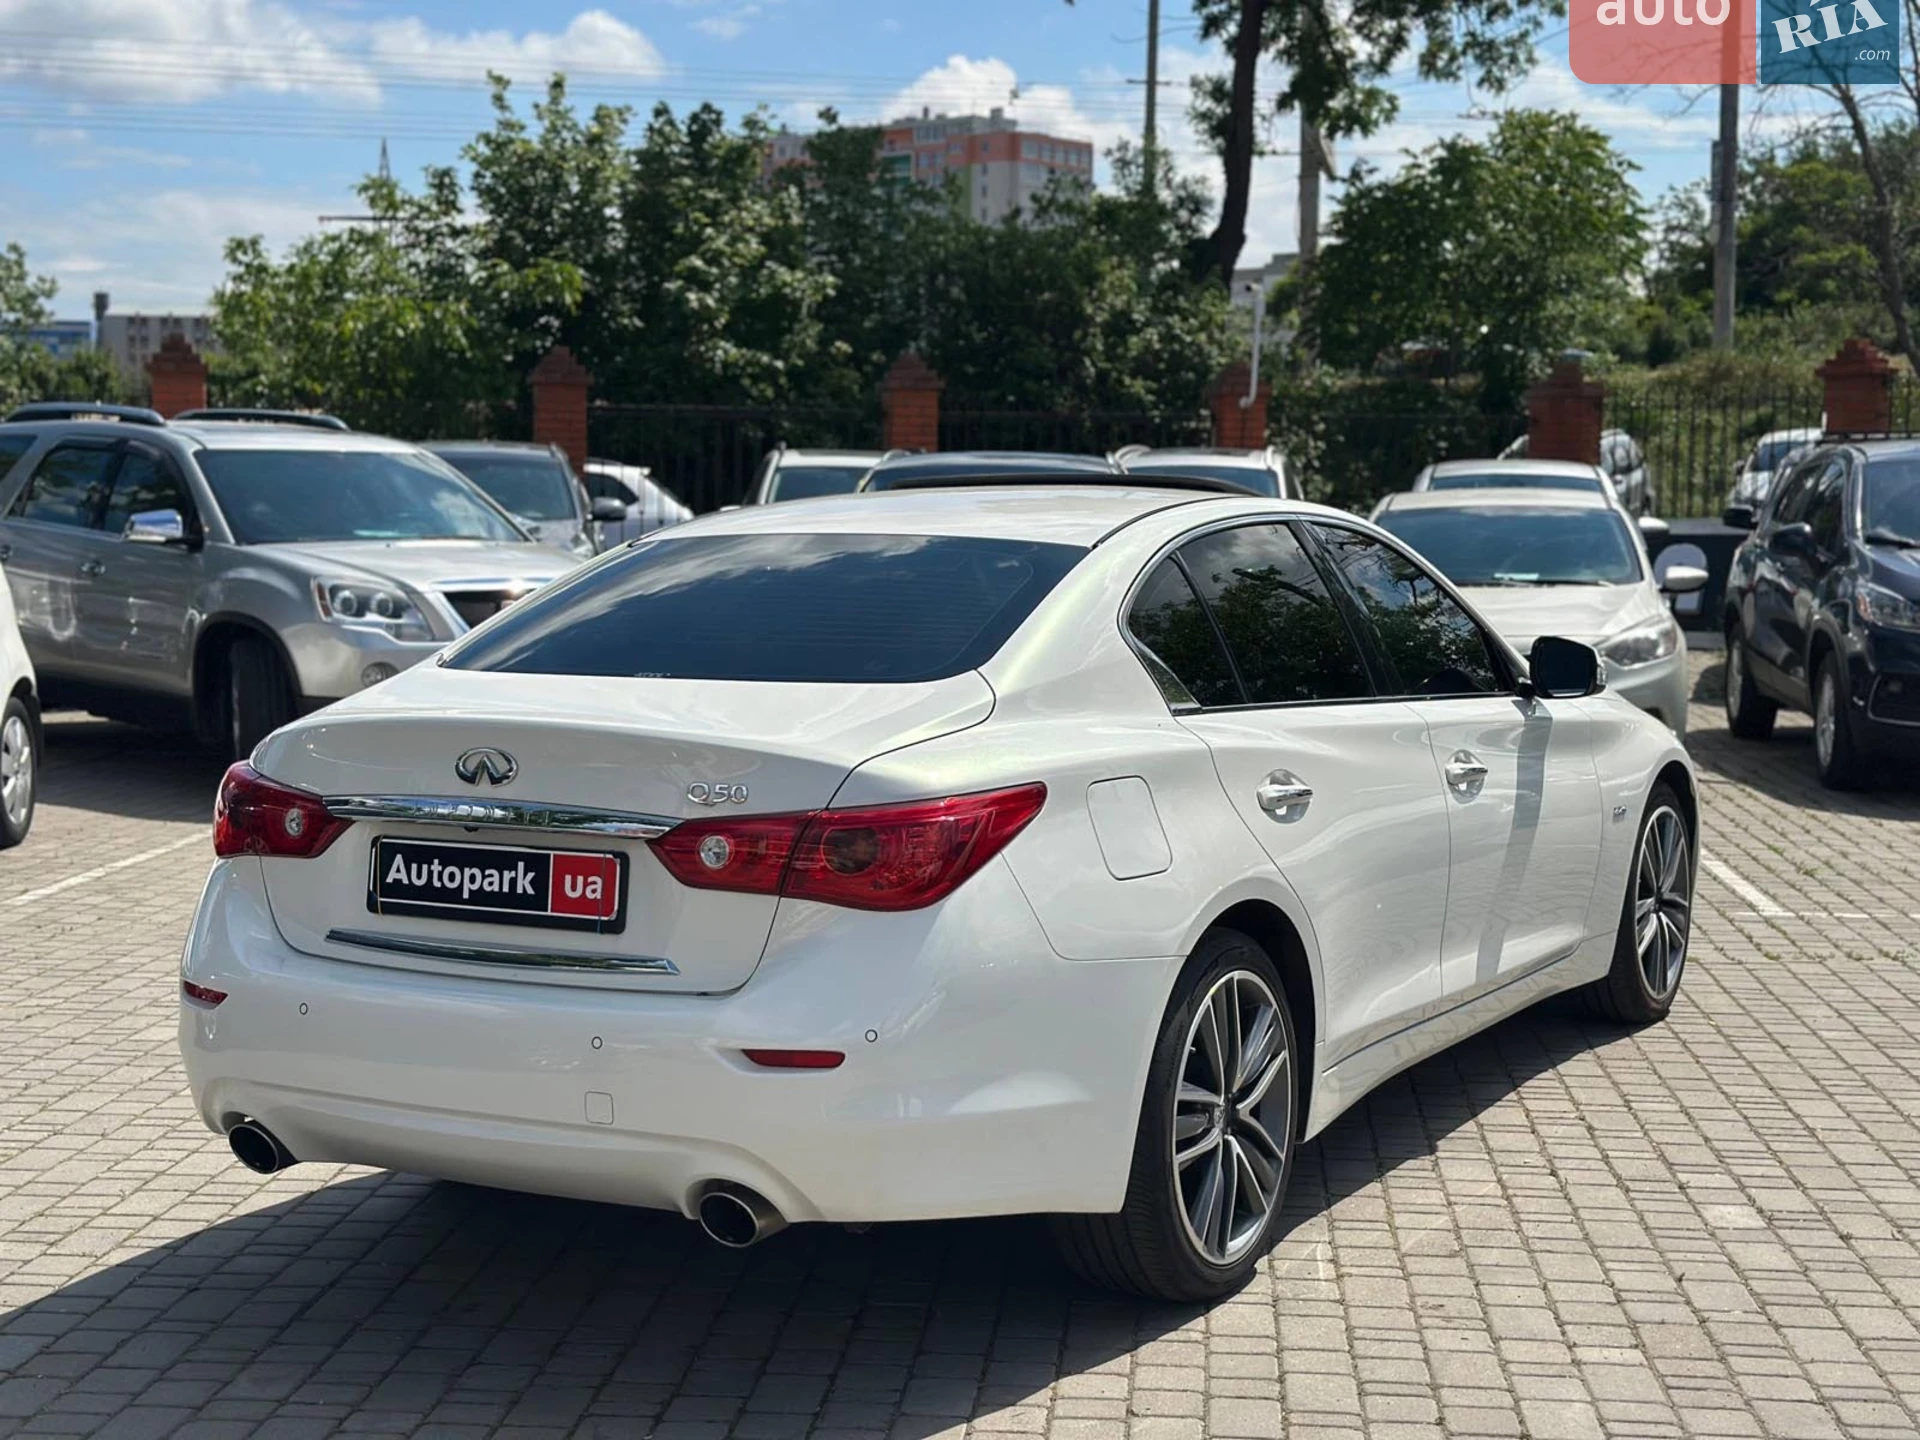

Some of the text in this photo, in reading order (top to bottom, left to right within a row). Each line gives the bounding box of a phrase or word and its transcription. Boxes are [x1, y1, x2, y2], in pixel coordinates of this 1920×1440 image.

[687, 782, 748, 806] Q50
[385, 853, 603, 900] Autopark ua
